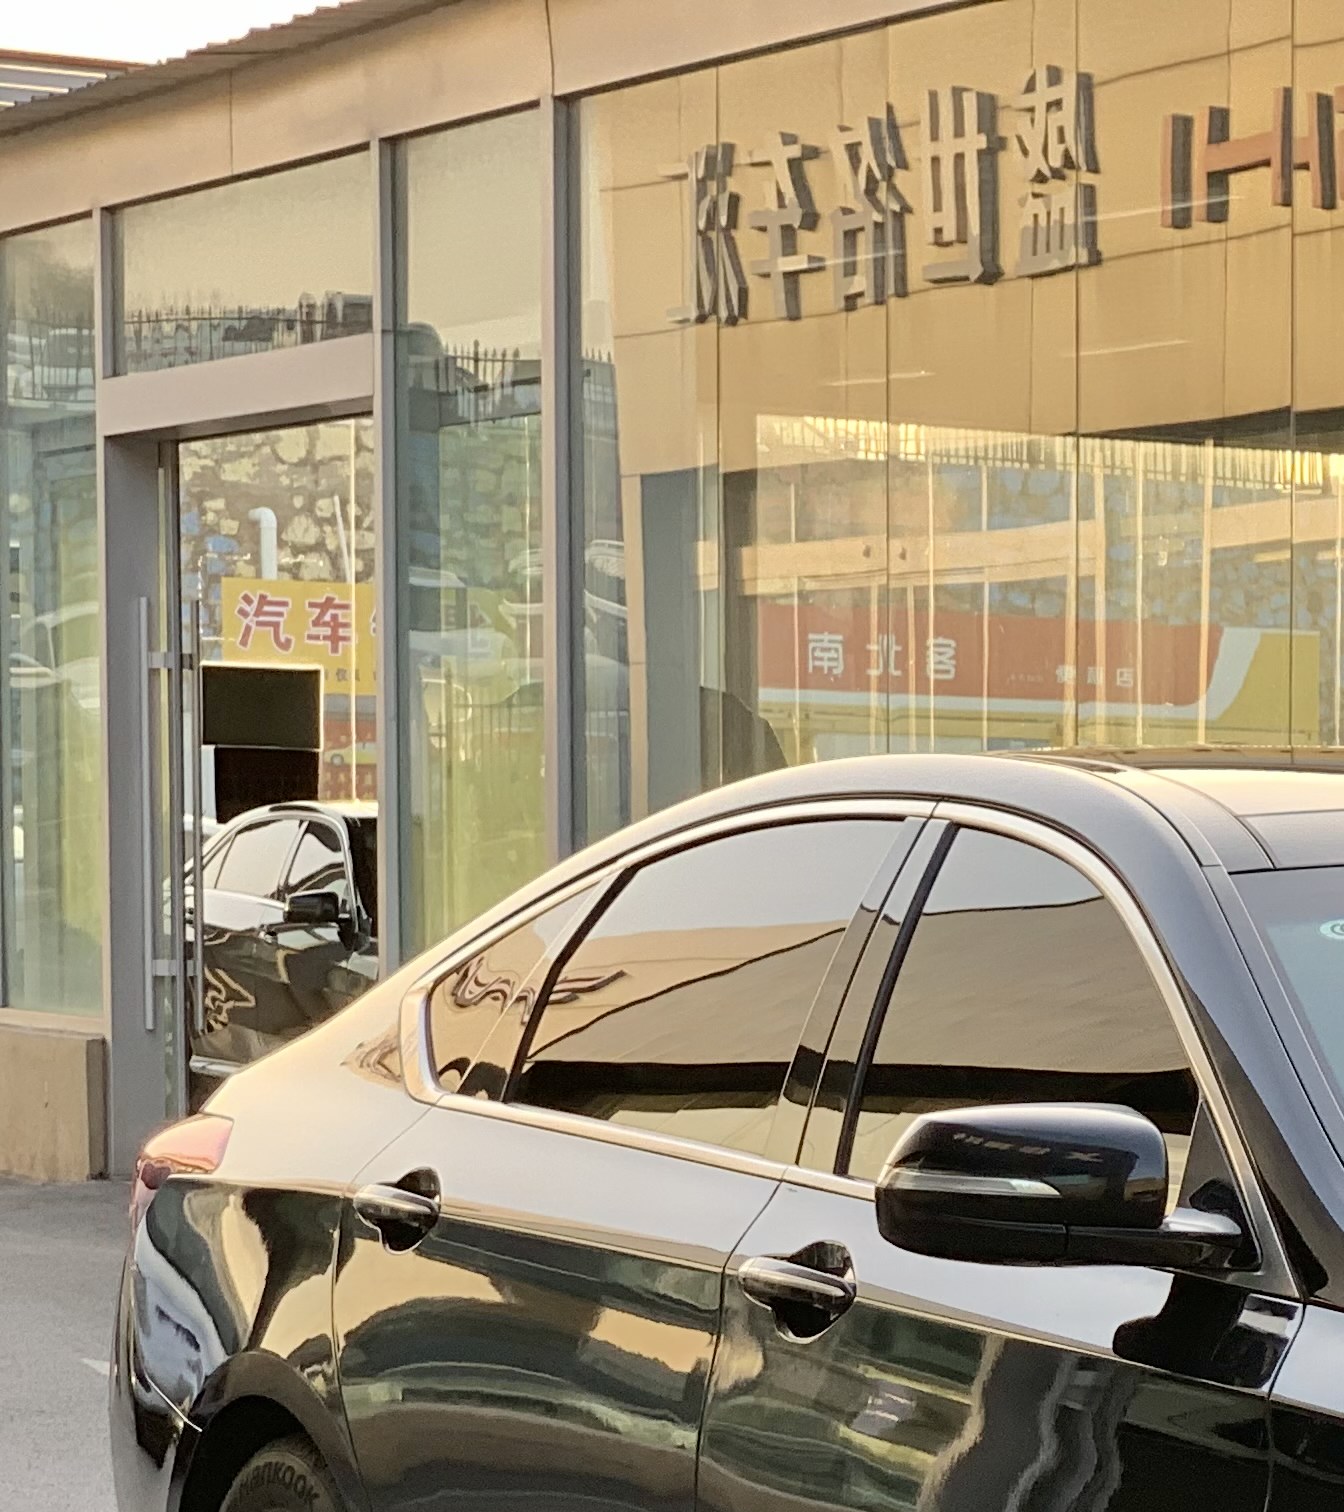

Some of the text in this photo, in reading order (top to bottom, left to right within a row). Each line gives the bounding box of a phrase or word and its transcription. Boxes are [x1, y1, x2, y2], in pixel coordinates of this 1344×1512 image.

[235, 589, 377, 656] 汽车
[807, 631, 957, 681] 南北客
